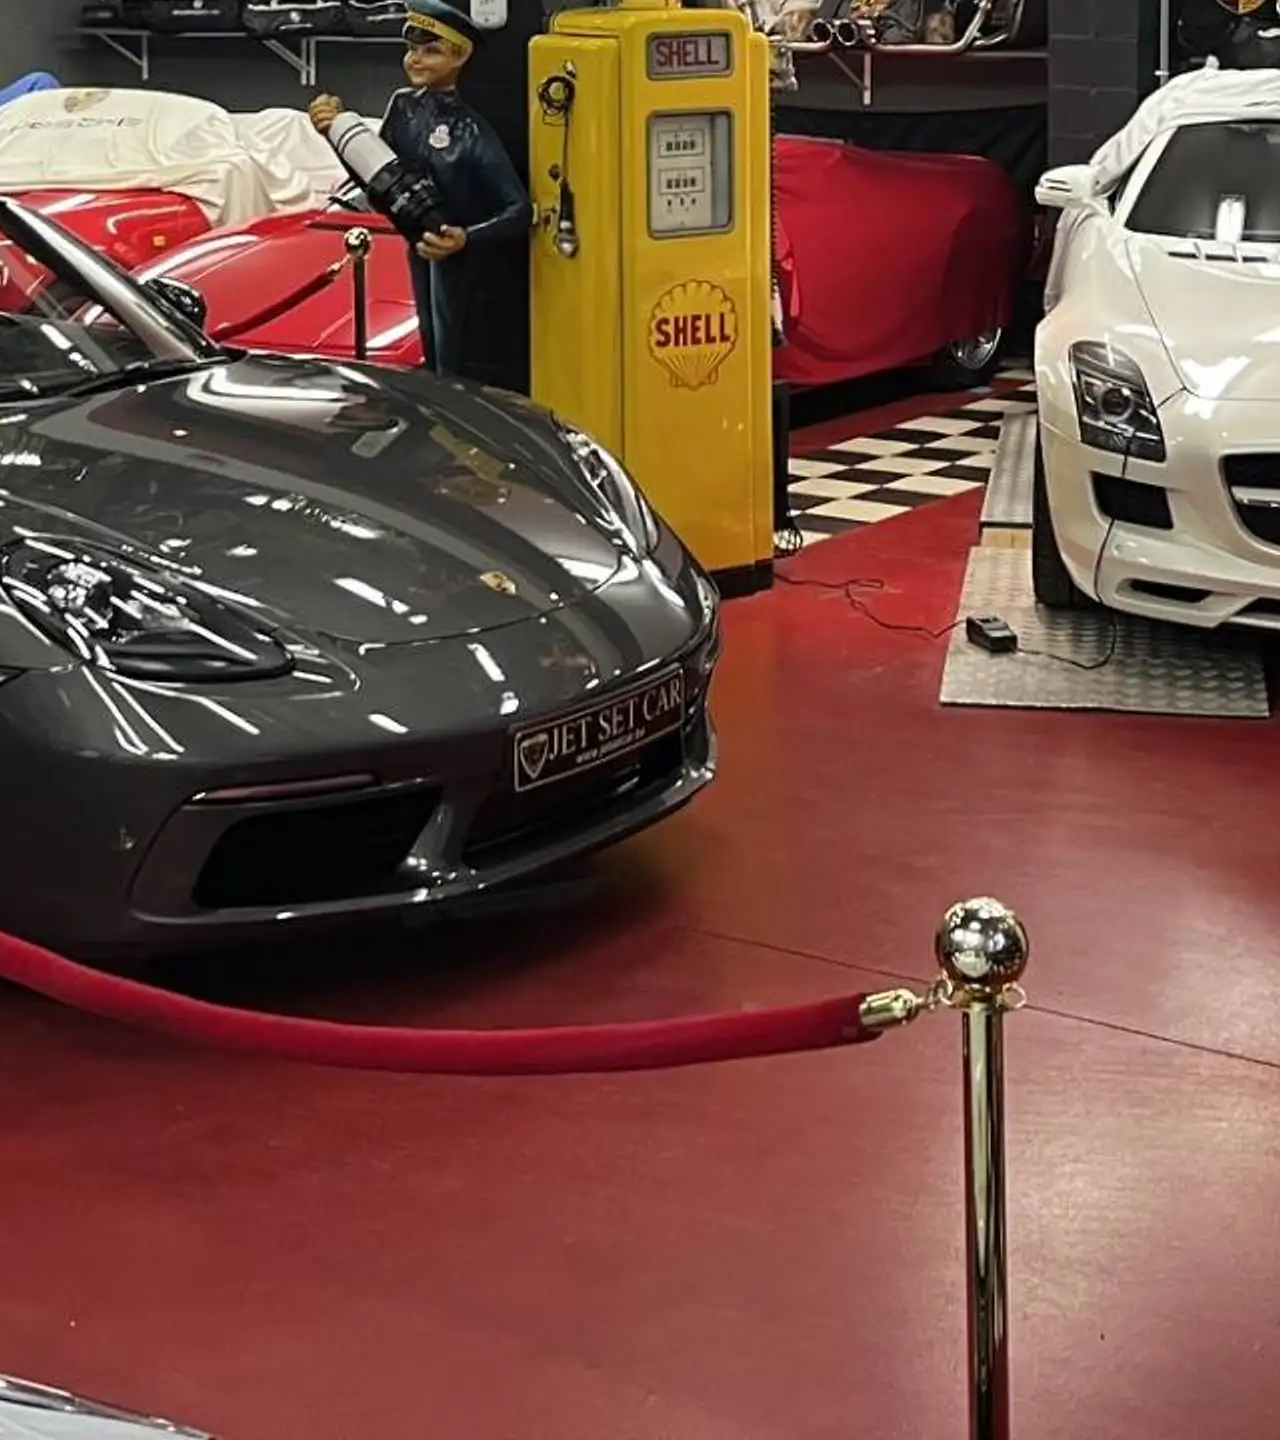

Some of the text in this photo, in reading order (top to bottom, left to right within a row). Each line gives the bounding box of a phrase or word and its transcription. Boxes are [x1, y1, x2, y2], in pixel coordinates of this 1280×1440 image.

[655, 38, 719, 69] SHELL
[654, 312, 732, 348] SHELL
[548, 715, 594, 761] JET
[598, 696, 639, 741] SET
[643, 677, 682, 721] CAR
